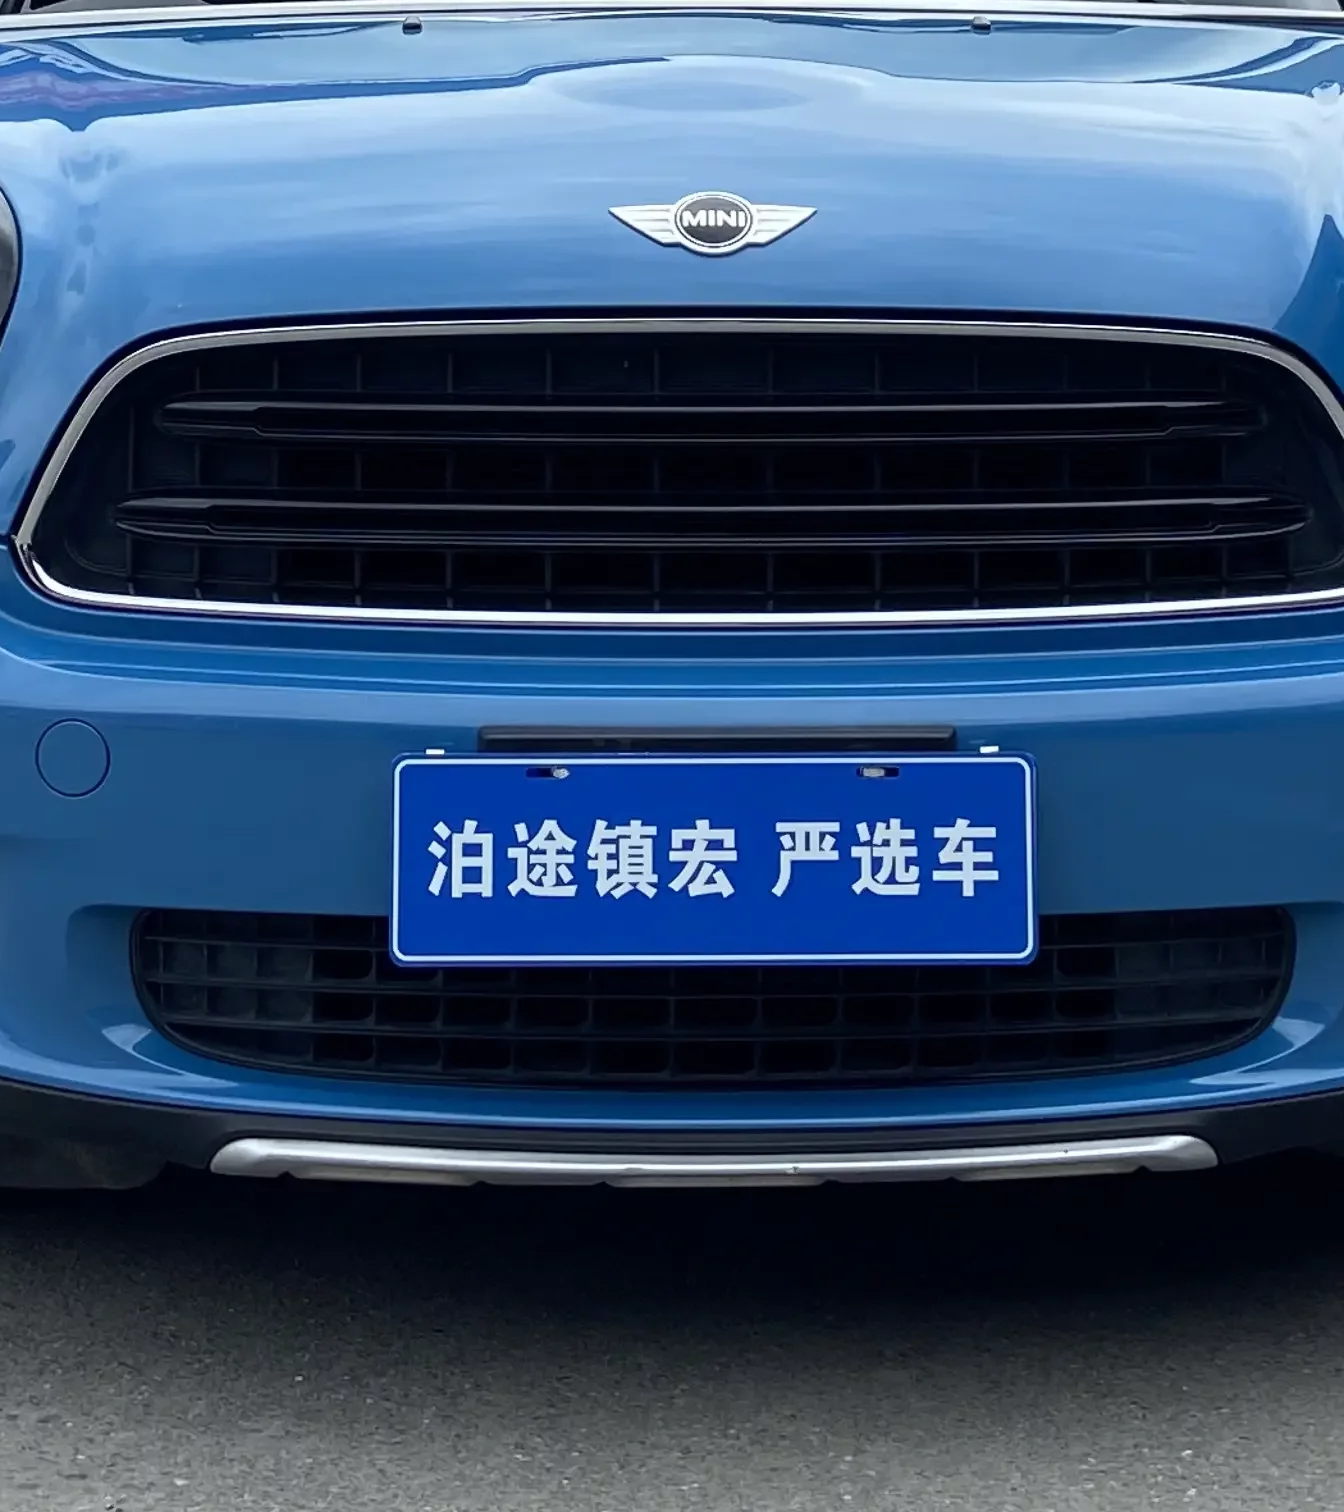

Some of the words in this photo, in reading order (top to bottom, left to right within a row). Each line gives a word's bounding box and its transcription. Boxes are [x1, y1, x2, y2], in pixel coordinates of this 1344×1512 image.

[682, 209, 746, 228] MINI
[426, 818, 738, 899] 泊途镇宏
[771, 818, 1000, 898] 严选车
